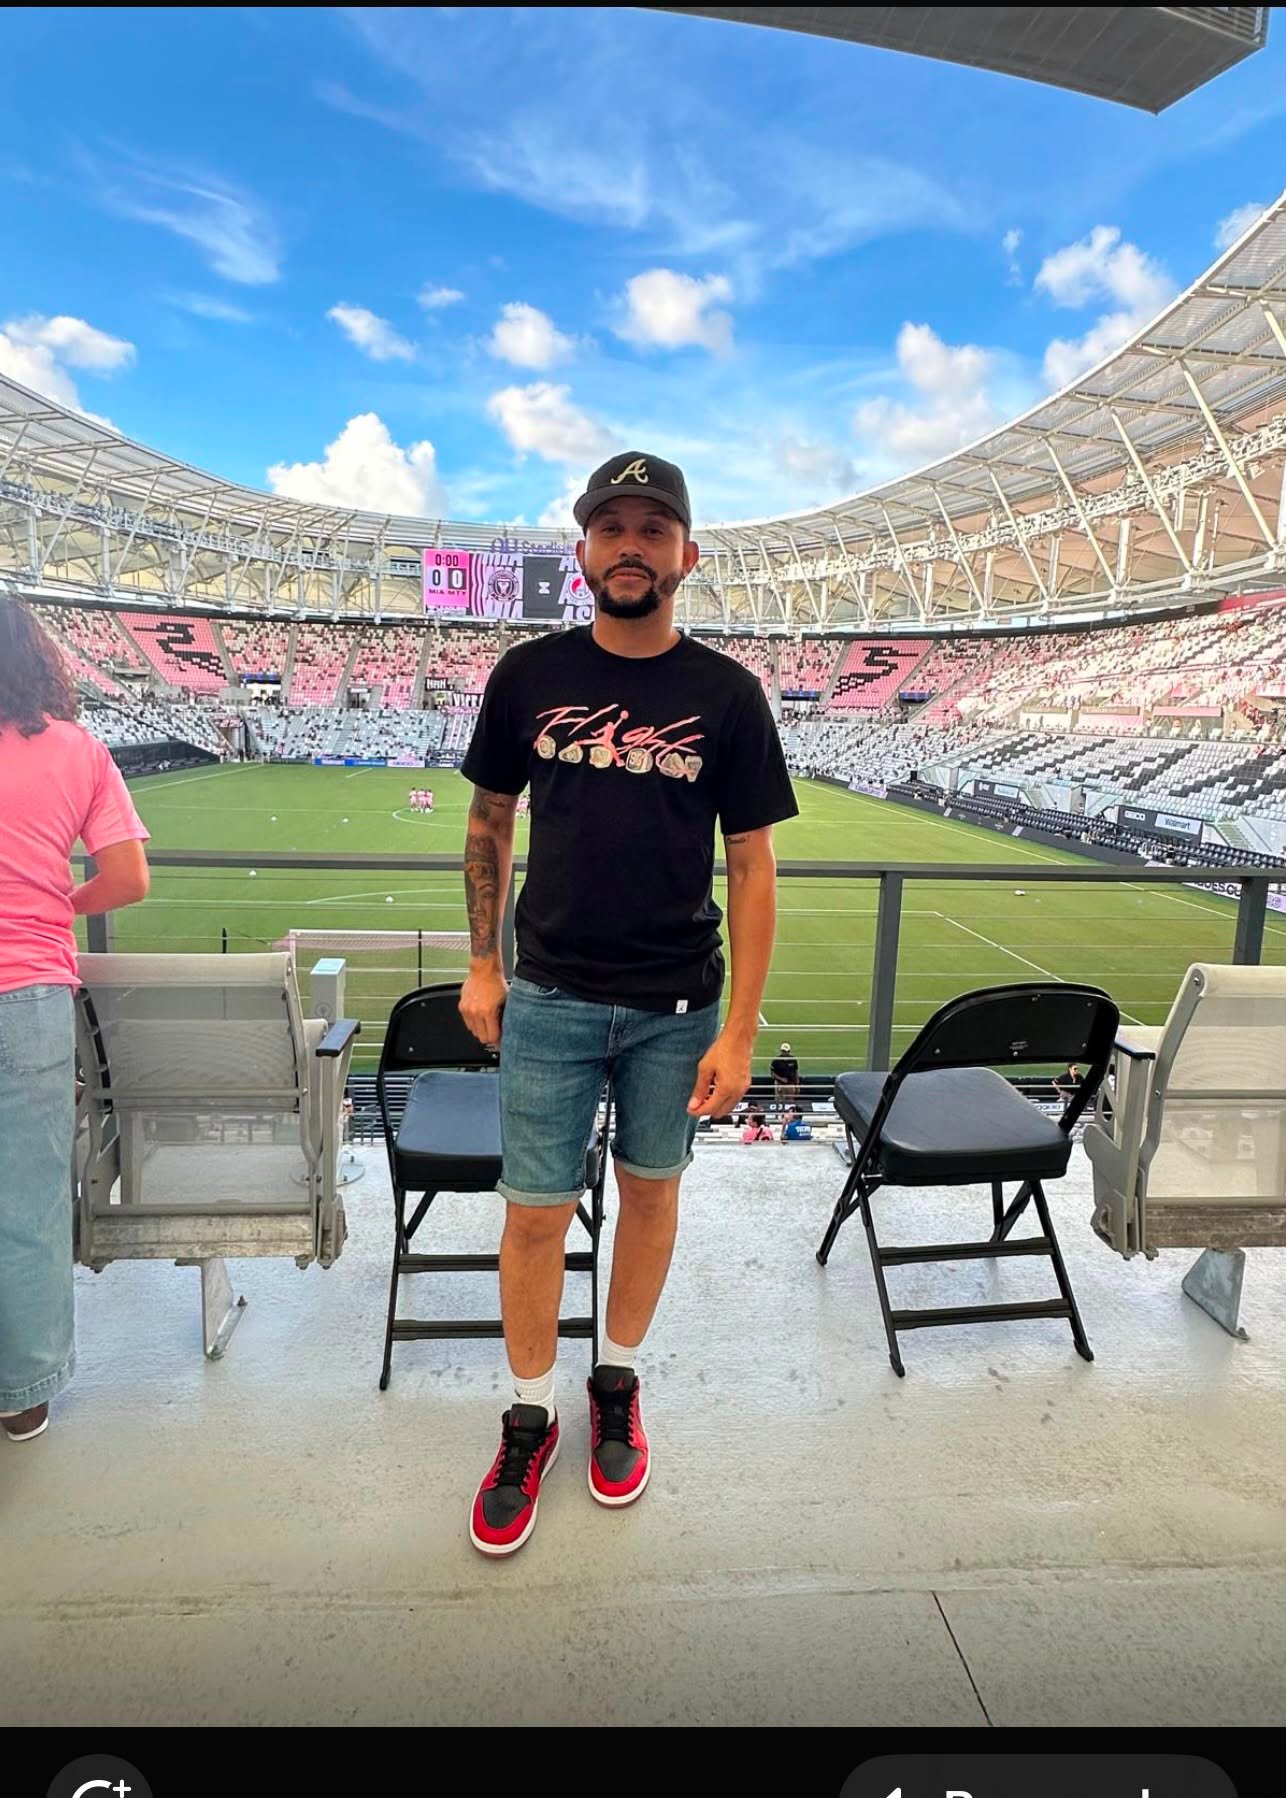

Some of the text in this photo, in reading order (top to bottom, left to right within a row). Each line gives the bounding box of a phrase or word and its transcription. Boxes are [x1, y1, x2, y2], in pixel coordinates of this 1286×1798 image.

[611, 459, 648, 484] A
[435, 554, 459, 567] 0:00
[432, 569, 441, 586] 0
[452, 569, 463, 588] 0
